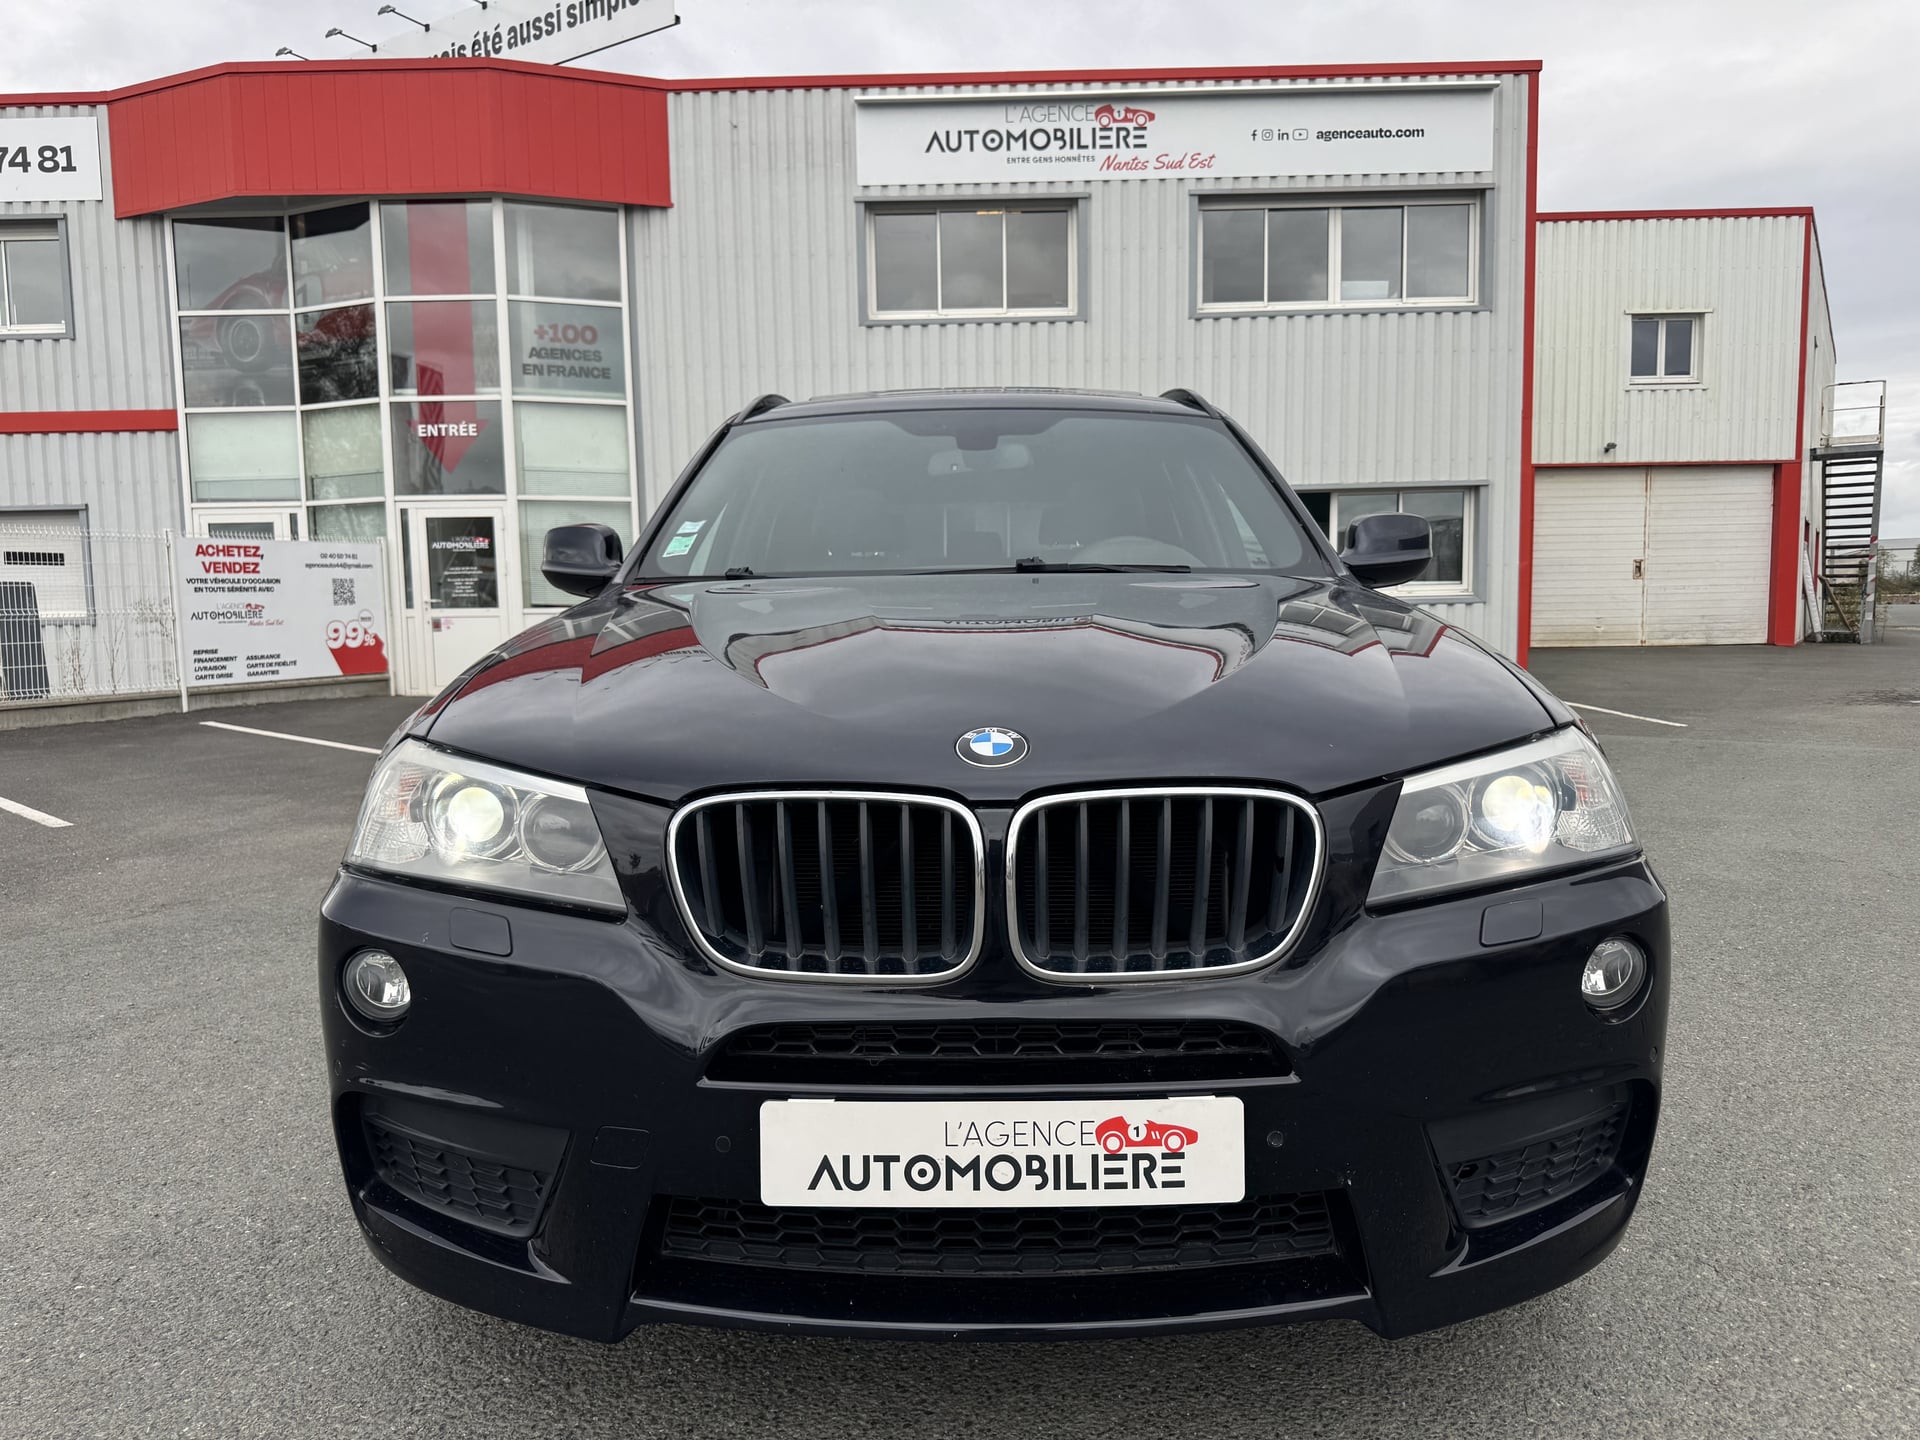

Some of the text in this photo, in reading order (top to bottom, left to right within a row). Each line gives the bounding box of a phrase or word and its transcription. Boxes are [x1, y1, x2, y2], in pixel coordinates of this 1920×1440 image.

[471, 23, 502, 58] été
[507, 3, 562, 50] aussi
[566, 0, 640, 28] simp
[1005, 104, 1095, 123] L'AGENCE
[1316, 127, 1425, 142] agenceauto.com
[37, 145, 77, 173] 81
[1007, 157, 1030, 165] ENTRE
[1054, 154, 1096, 163] HONNÊTES
[1099, 152, 1216, 172] Nantes Sud Est
[534, 323, 598, 345] +100
[528, 346, 602, 362] AGENCES
[522, 363, 611, 379] EN FRANCE
[418, 421, 478, 437] ENTRÉE
[195, 544, 264, 560] ACHETEZ,
[201, 561, 261, 574] VENDEZ
[186, 576, 281, 585] VOTRE VÉHICULE D'OCCASION
[193, 655, 238, 664] FINANCEMENT
[247, 669, 280, 677] GARANTIES
[945, 1120, 1096, 1147] L'AGENCE
